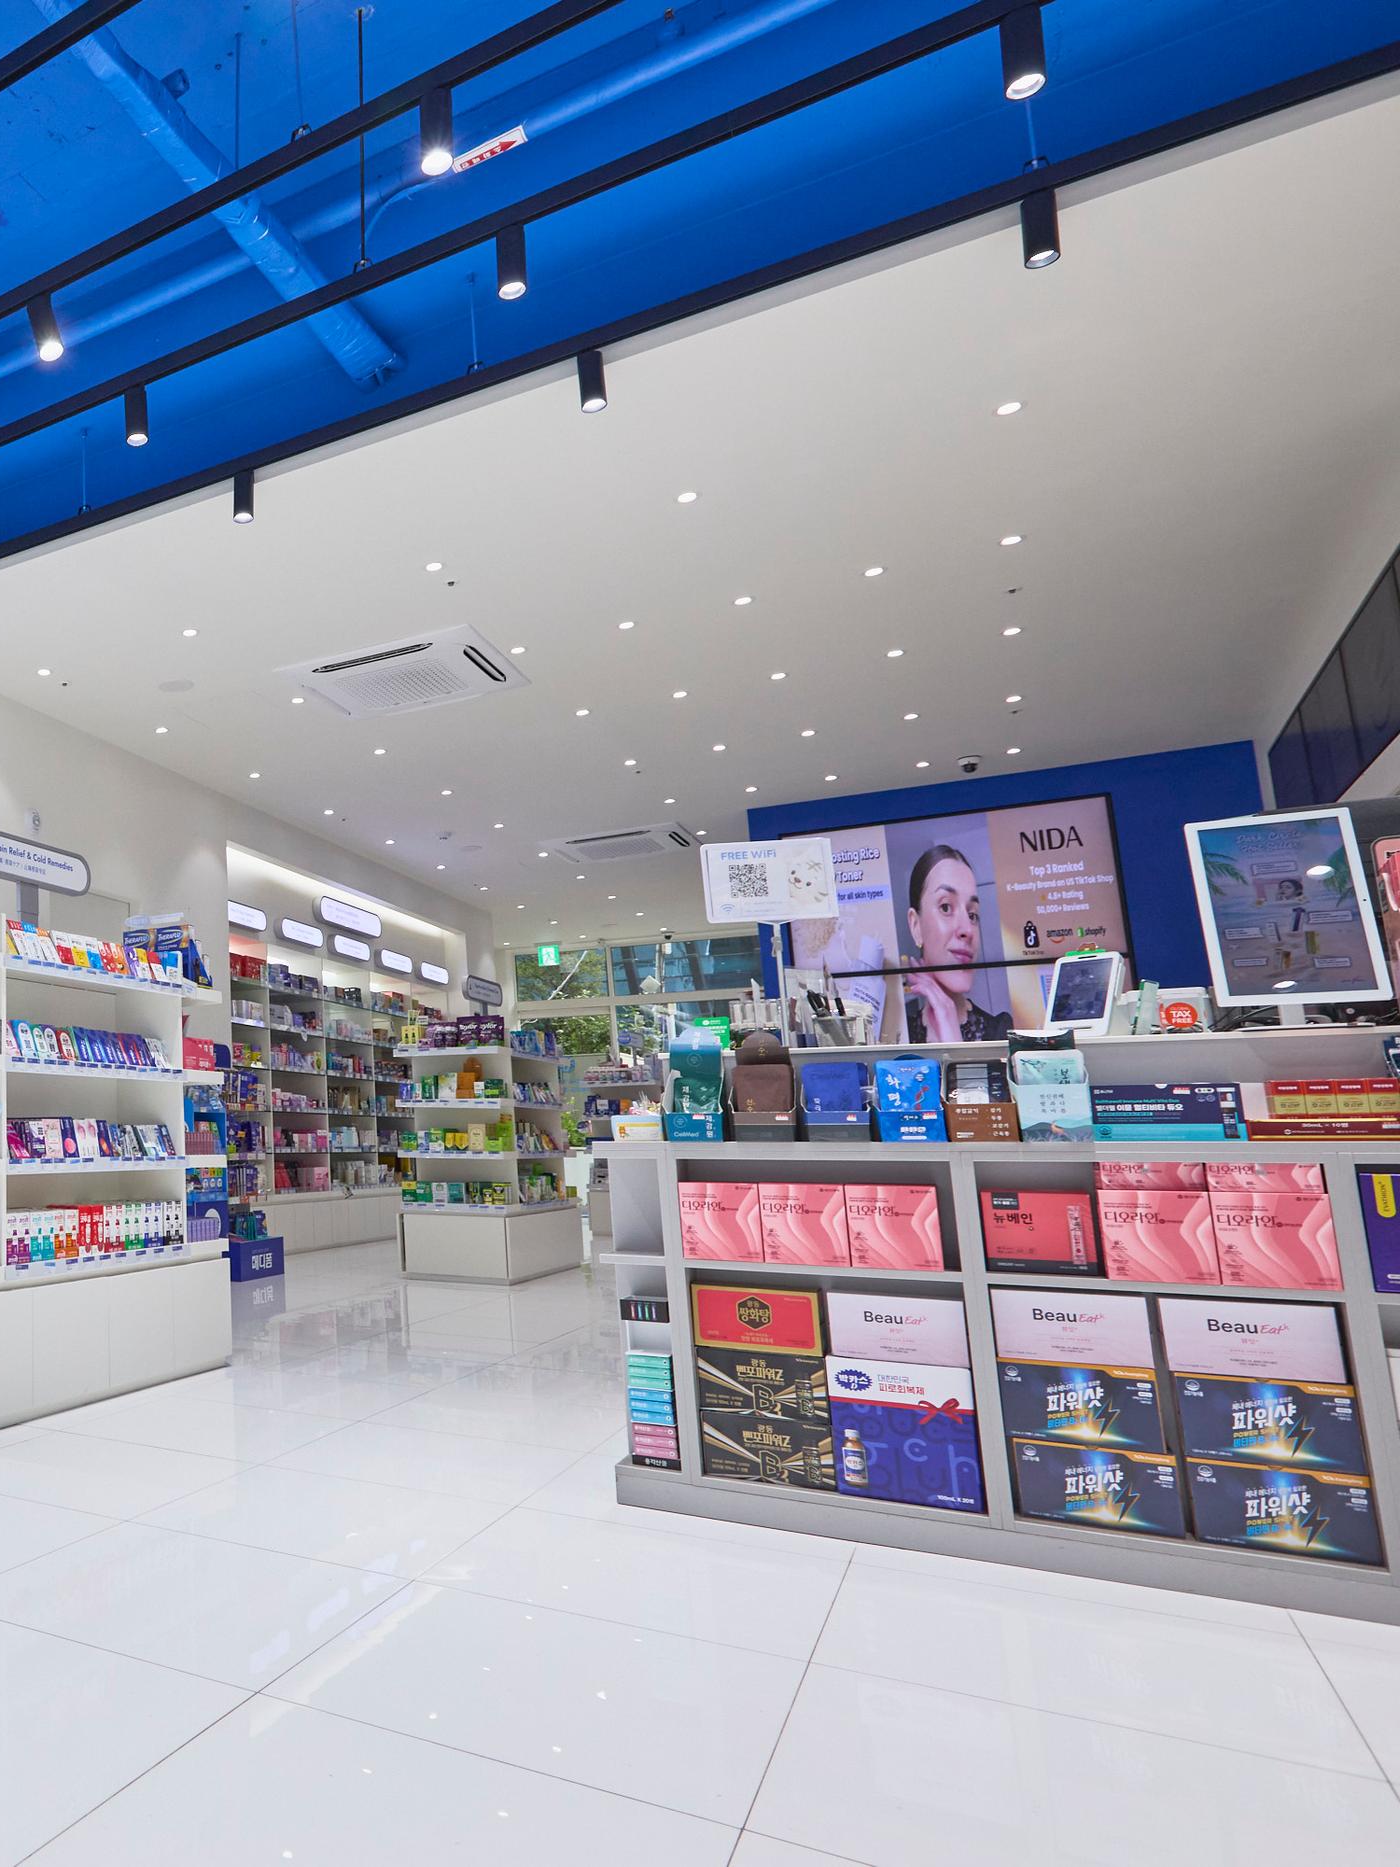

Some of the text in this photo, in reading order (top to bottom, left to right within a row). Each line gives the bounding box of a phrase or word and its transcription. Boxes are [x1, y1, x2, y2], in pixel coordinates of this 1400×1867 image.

[1019, 826, 1084, 853] NIDA
[8, 847, 26, 858] Relief
[32, 854, 47, 864] Cold
[720, 849, 776, 861] FREE WiFi
[832, 847, 880, 865] osting Rice
[1029, 861, 1084, 878] Top 3 Ranked
[837, 871, 863, 883] Toner
[1075, 876, 1096, 885] TikTok
[1097, 874, 1114, 885] Shop
[838, 893, 846, 901] for
[854, 891, 866, 900] skin
[867, 890, 884, 900] types
[1062, 890, 1084, 900] Rating
[1063, 902, 1090, 912] Reviews
[158, 932, 181, 942] THERAFLU
[1047, 926, 1106, 937] amazon shopify
[1170, 1010, 1192, 1018] TAX
[993, 1211, 1034, 1225] 뉴베인
[864, 1311, 903, 1325] Beau
[1032, 1308, 1077, 1323] Beau
[1207, 1318, 1258, 1334] Beau
[877, 1373, 910, 1385] 대한민국
[879, 1383, 926, 1396] 피로회복제
[1046, 1386, 1104, 1412] 파워샷
[1232, 1403, 1297, 1430] 파워샷
[1065, 1471, 1124, 1494] 파워샷
[1245, 1492, 1311, 1518] 파워샷
